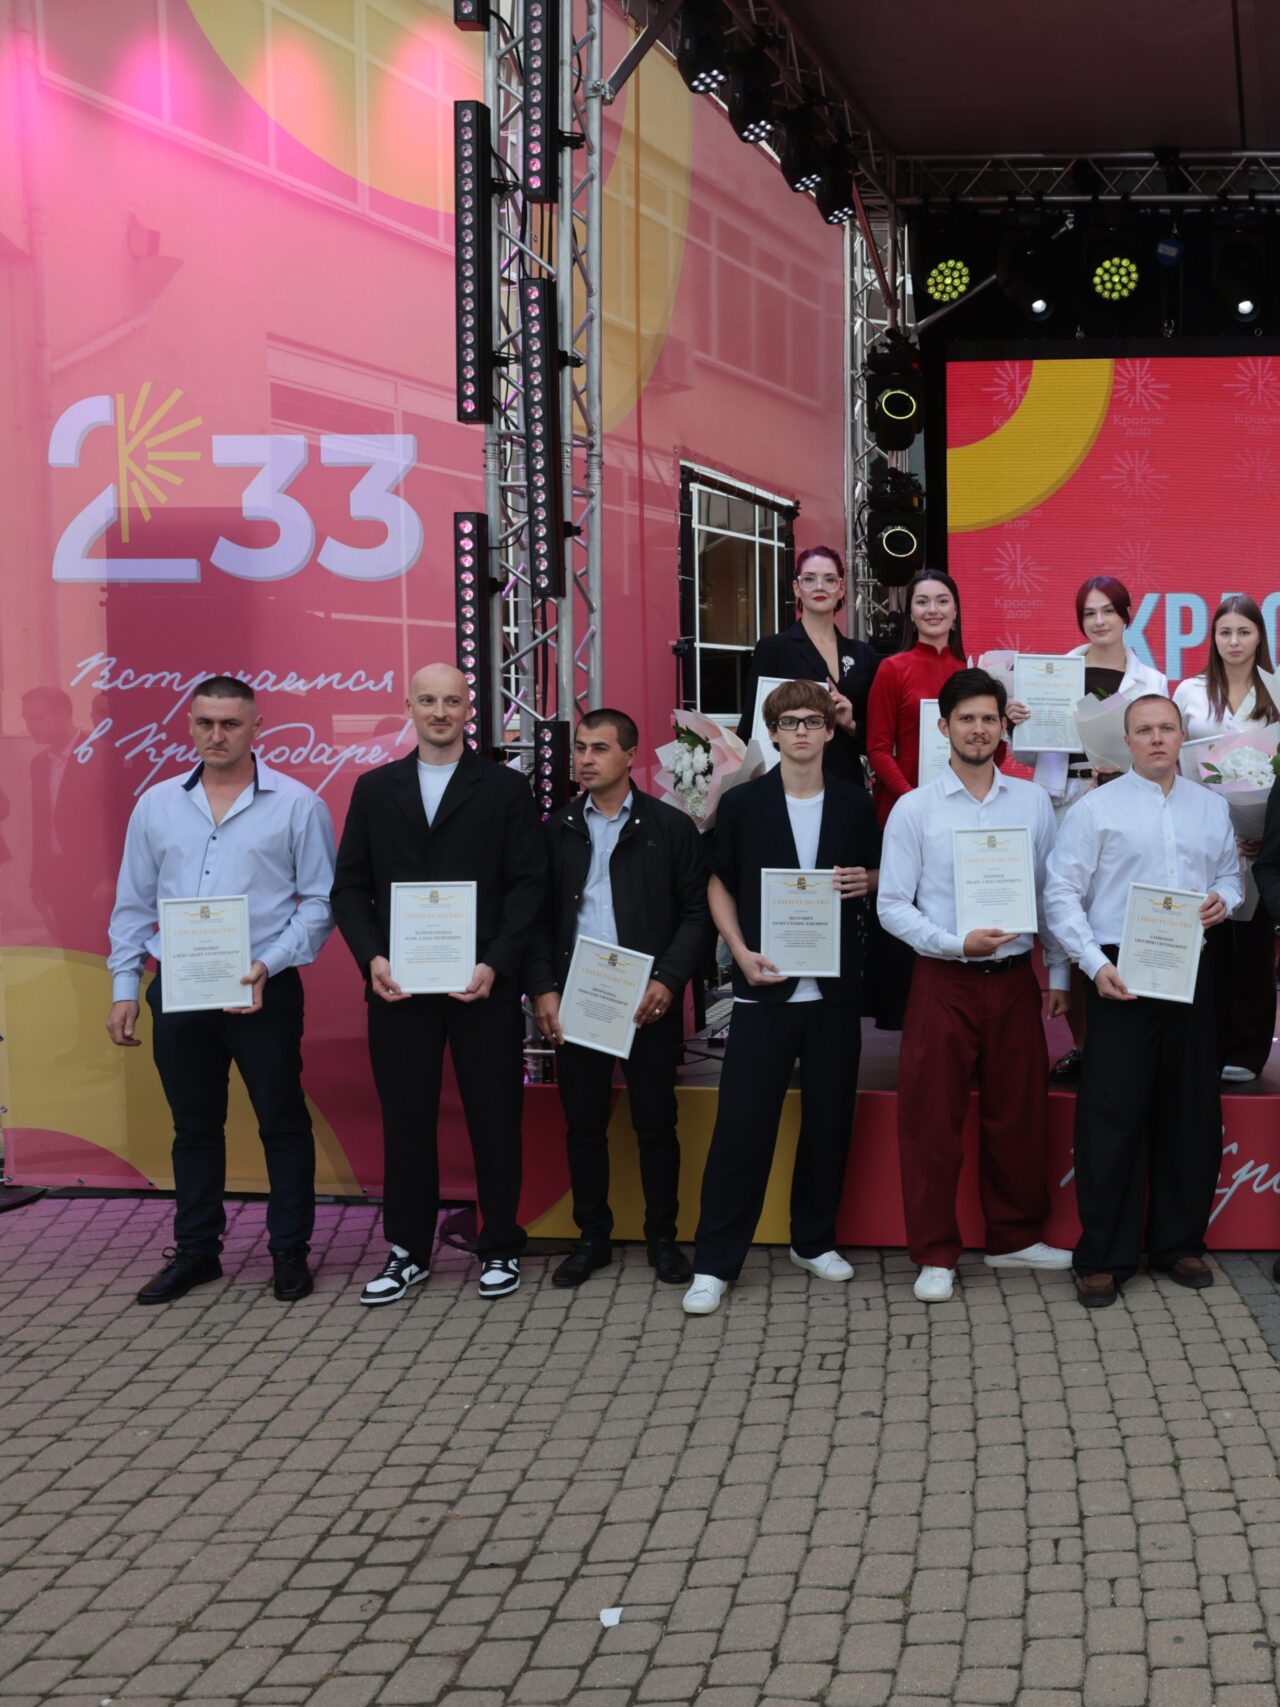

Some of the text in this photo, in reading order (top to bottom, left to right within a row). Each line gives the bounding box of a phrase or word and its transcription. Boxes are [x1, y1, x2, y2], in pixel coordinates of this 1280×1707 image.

[48, 394, 424, 583] 233
[70, 651, 395, 726] Встраемся
[73, 717, 414, 797] в Кродаре!
